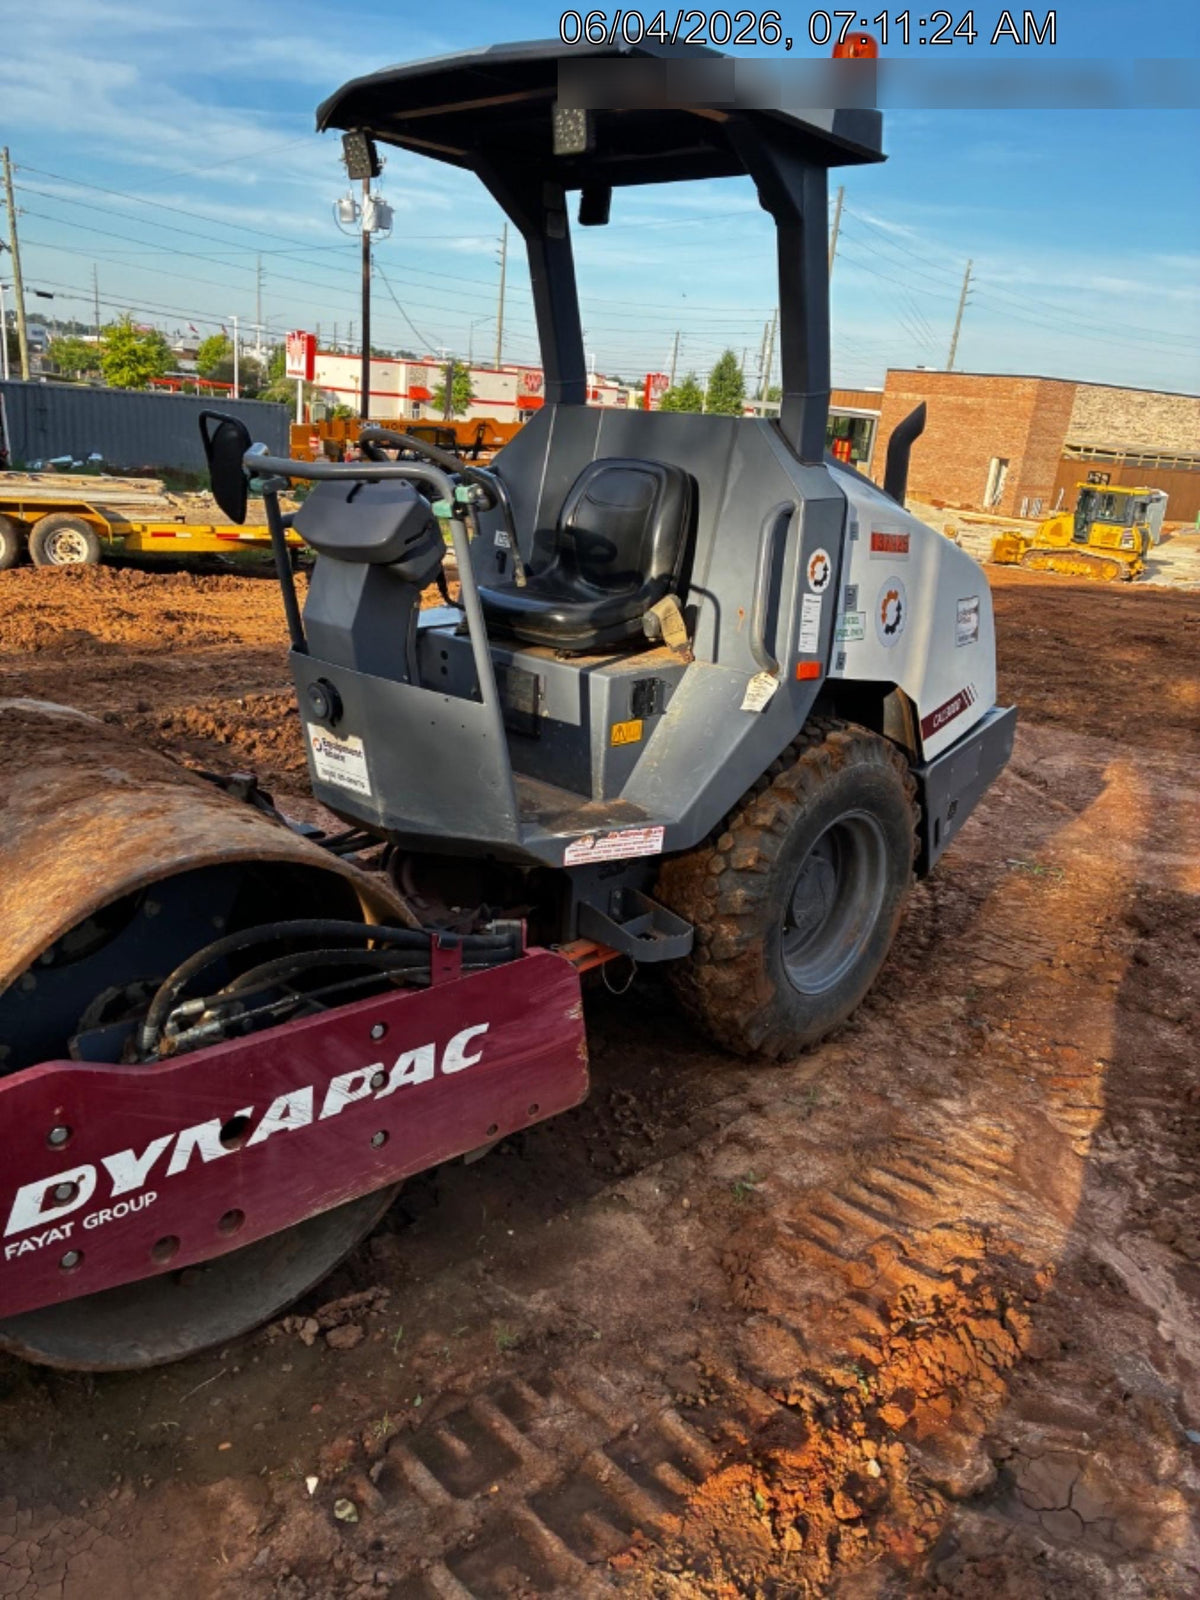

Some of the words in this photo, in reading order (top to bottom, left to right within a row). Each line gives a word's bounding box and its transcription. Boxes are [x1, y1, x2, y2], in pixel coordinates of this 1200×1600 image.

[3, 1022, 490, 1237] DYNAPAC
[3, 1221, 76, 1262] FAYAT
[82, 1190, 158, 1230] GROUP
